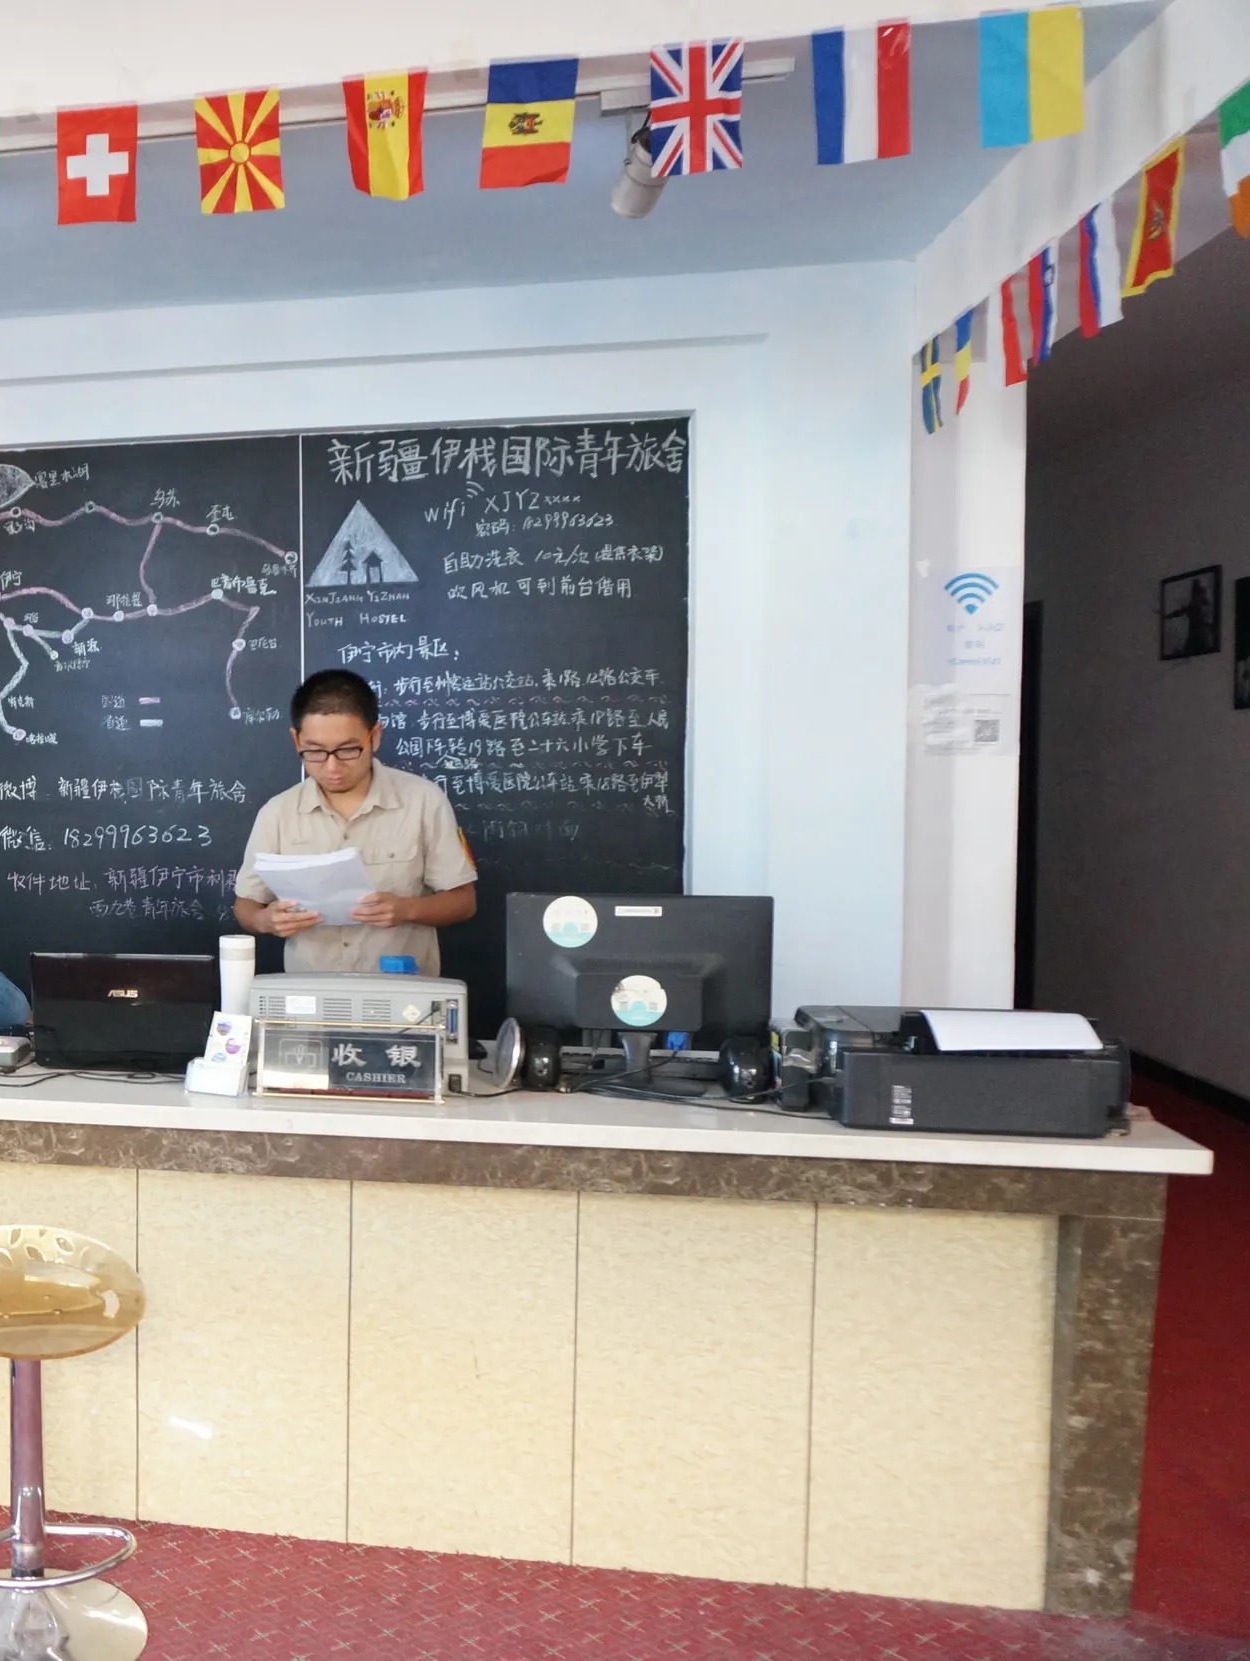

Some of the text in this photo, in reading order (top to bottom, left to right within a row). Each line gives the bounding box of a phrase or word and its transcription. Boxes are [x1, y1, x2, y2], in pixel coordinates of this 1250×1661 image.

[327, 427, 687, 485] 新疆伊栈国际青年旅舍
[443, 547, 524, 575] 自助洗衣
[64, 825, 213, 849] 18299963623
[107, 989, 138, 999] ASUS
[331, 1043, 422, 1069] 收银
[346, 1071, 406, 1085] CASHIER
